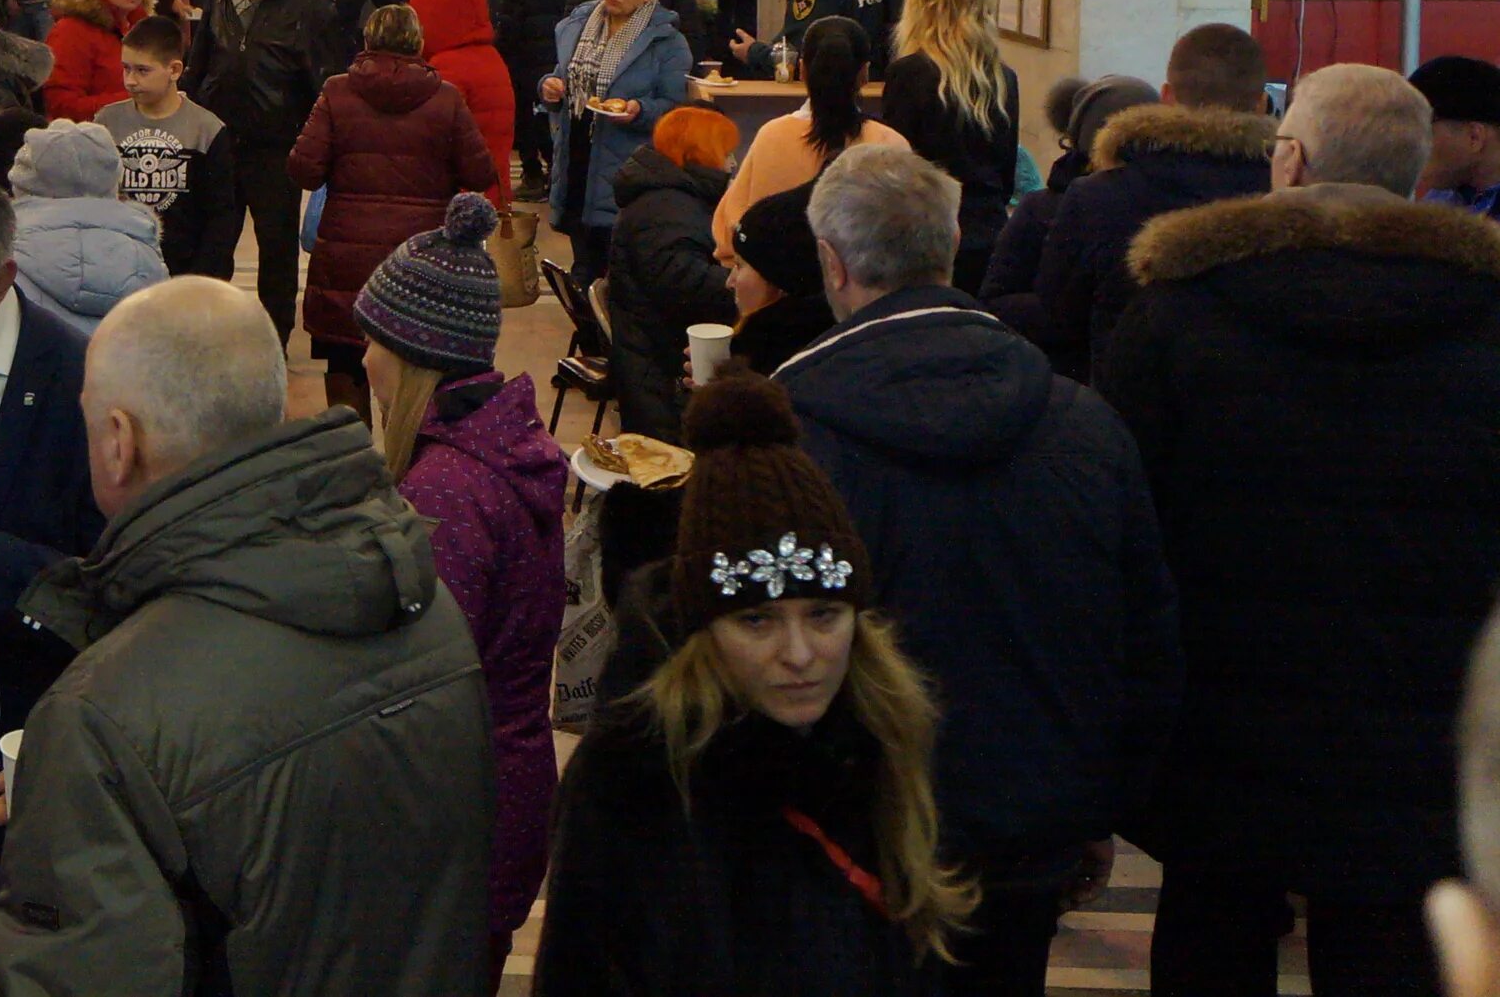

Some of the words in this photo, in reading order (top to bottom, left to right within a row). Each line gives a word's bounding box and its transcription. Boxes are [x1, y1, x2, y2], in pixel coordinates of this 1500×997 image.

[120, 128, 151, 150] MOTOR
[154, 129, 184, 152] RACER
[151, 161, 188, 189] RIDE
